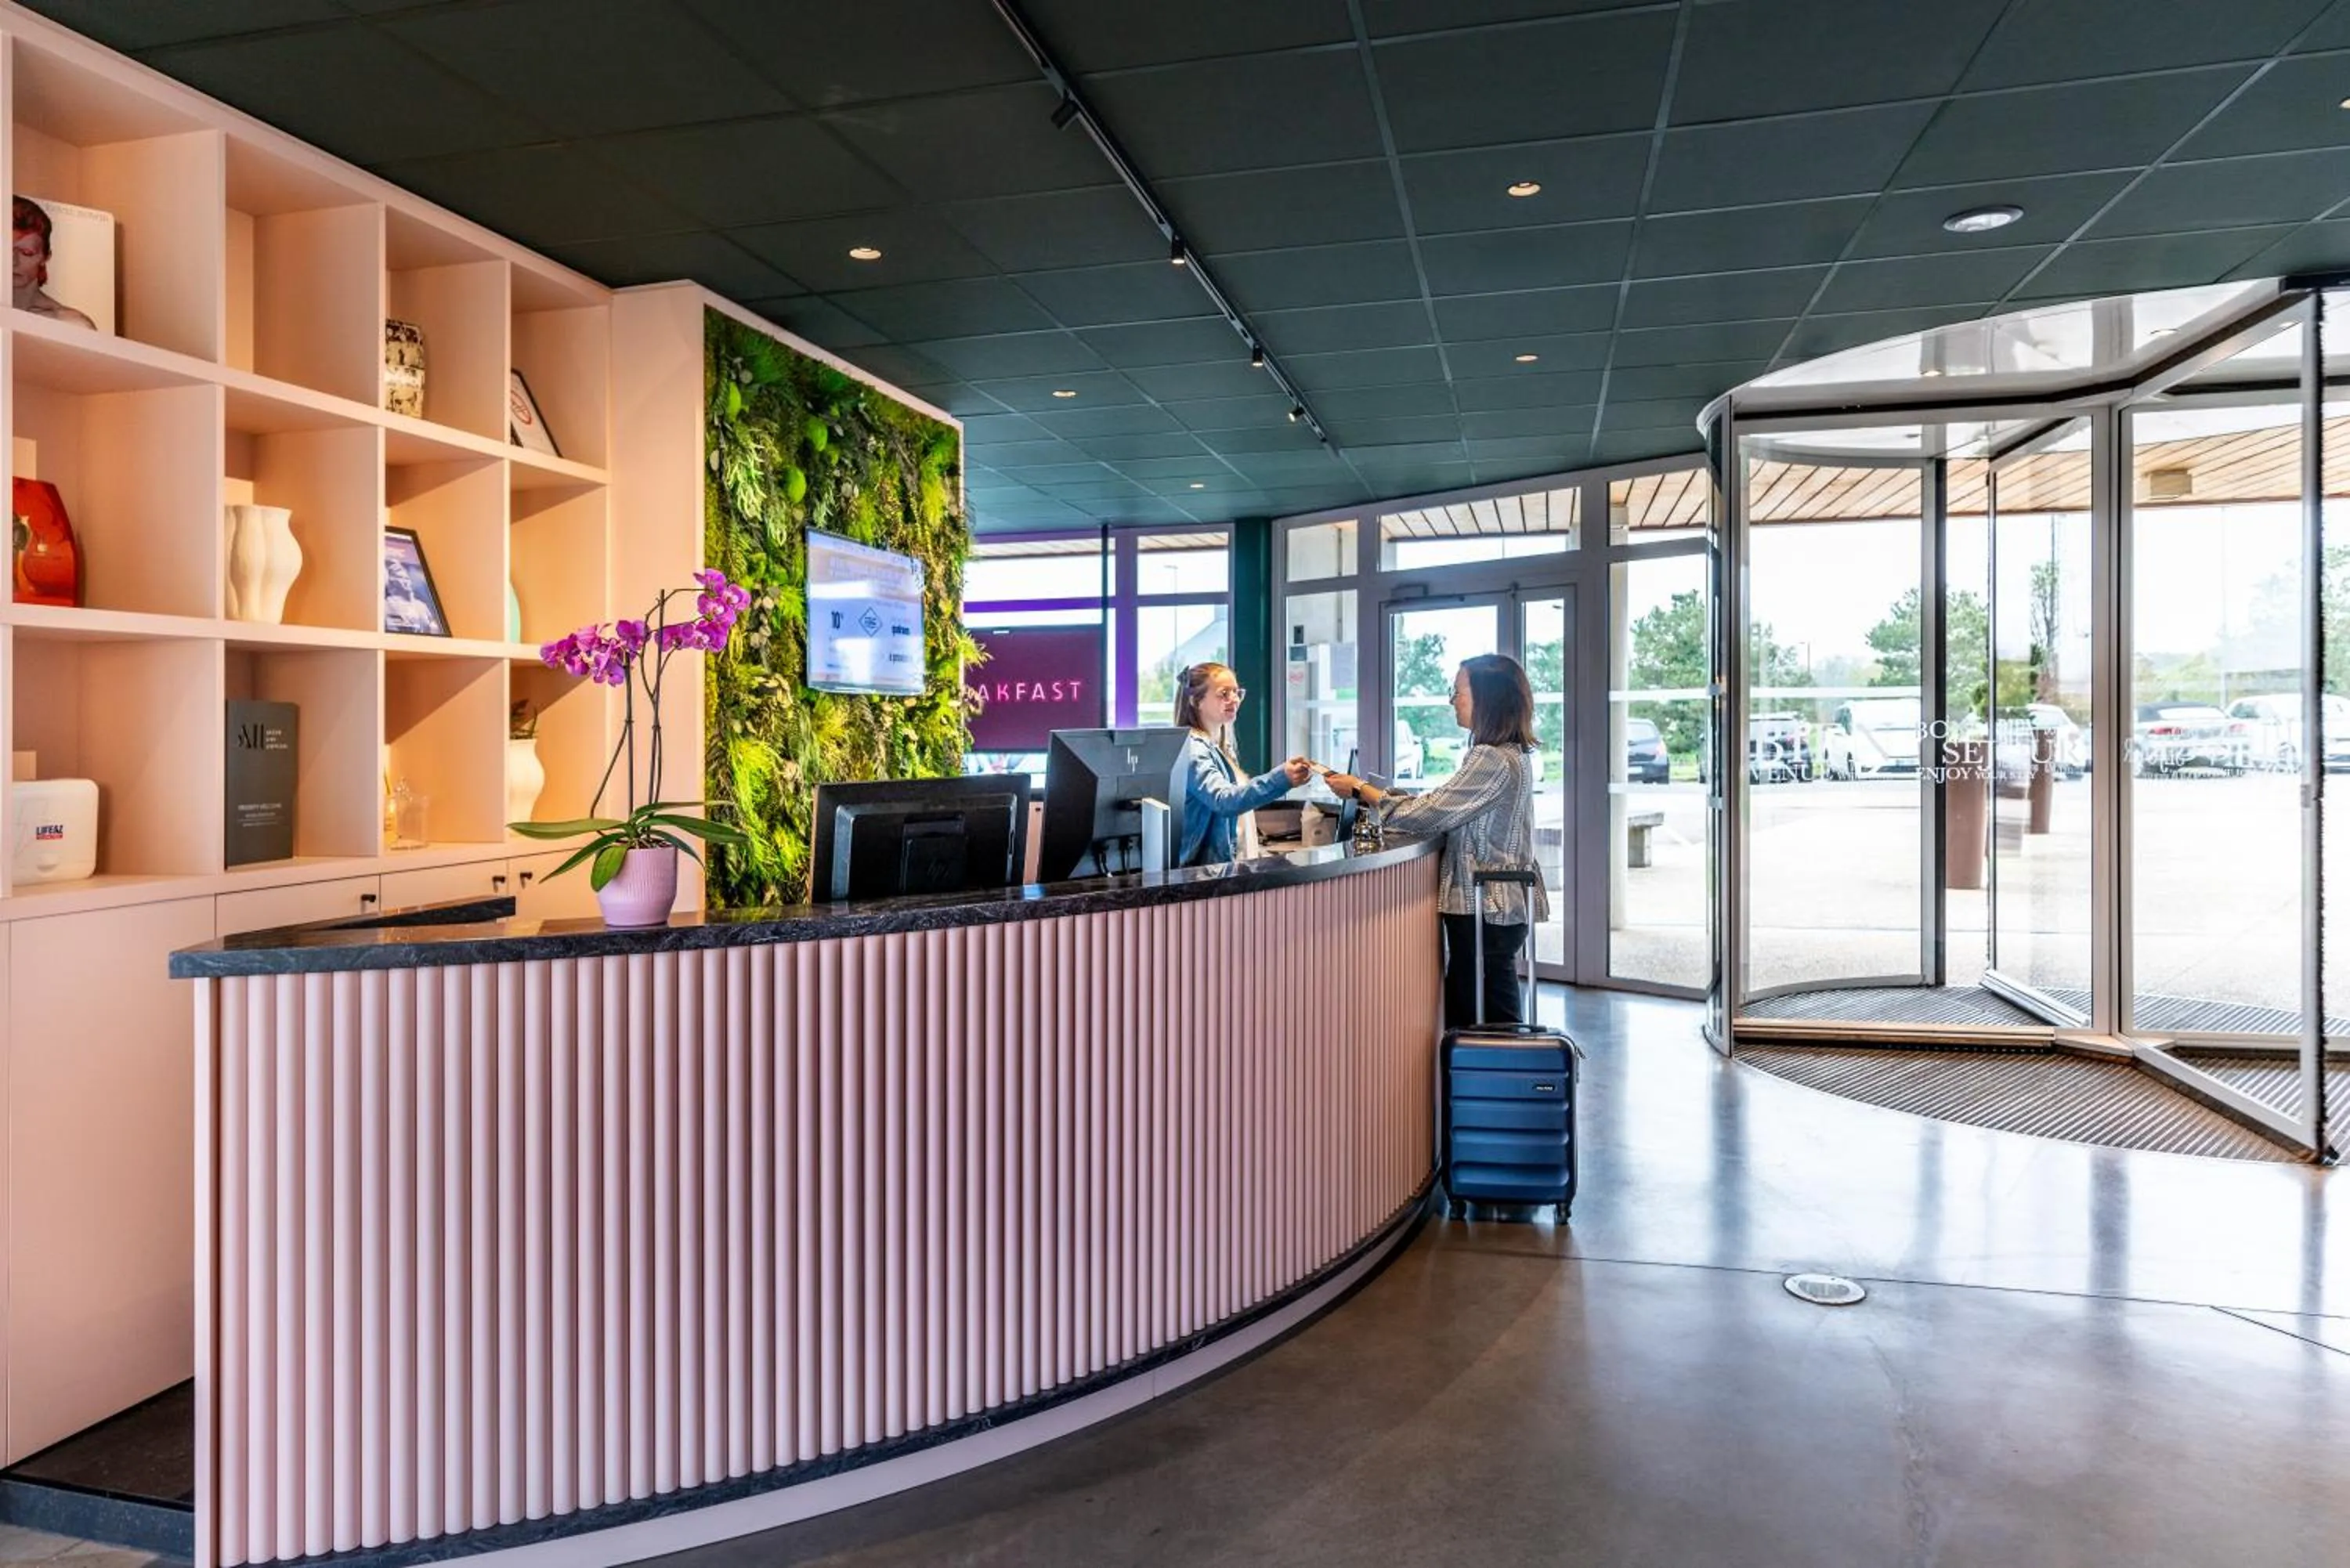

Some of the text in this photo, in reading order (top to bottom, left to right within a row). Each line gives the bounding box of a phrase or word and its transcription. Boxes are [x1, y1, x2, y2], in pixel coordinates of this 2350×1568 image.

[978, 681, 1081, 702] AKFAST
[1127, 747, 1138, 773] hp
[1916, 767, 1972, 783] ENJOY
